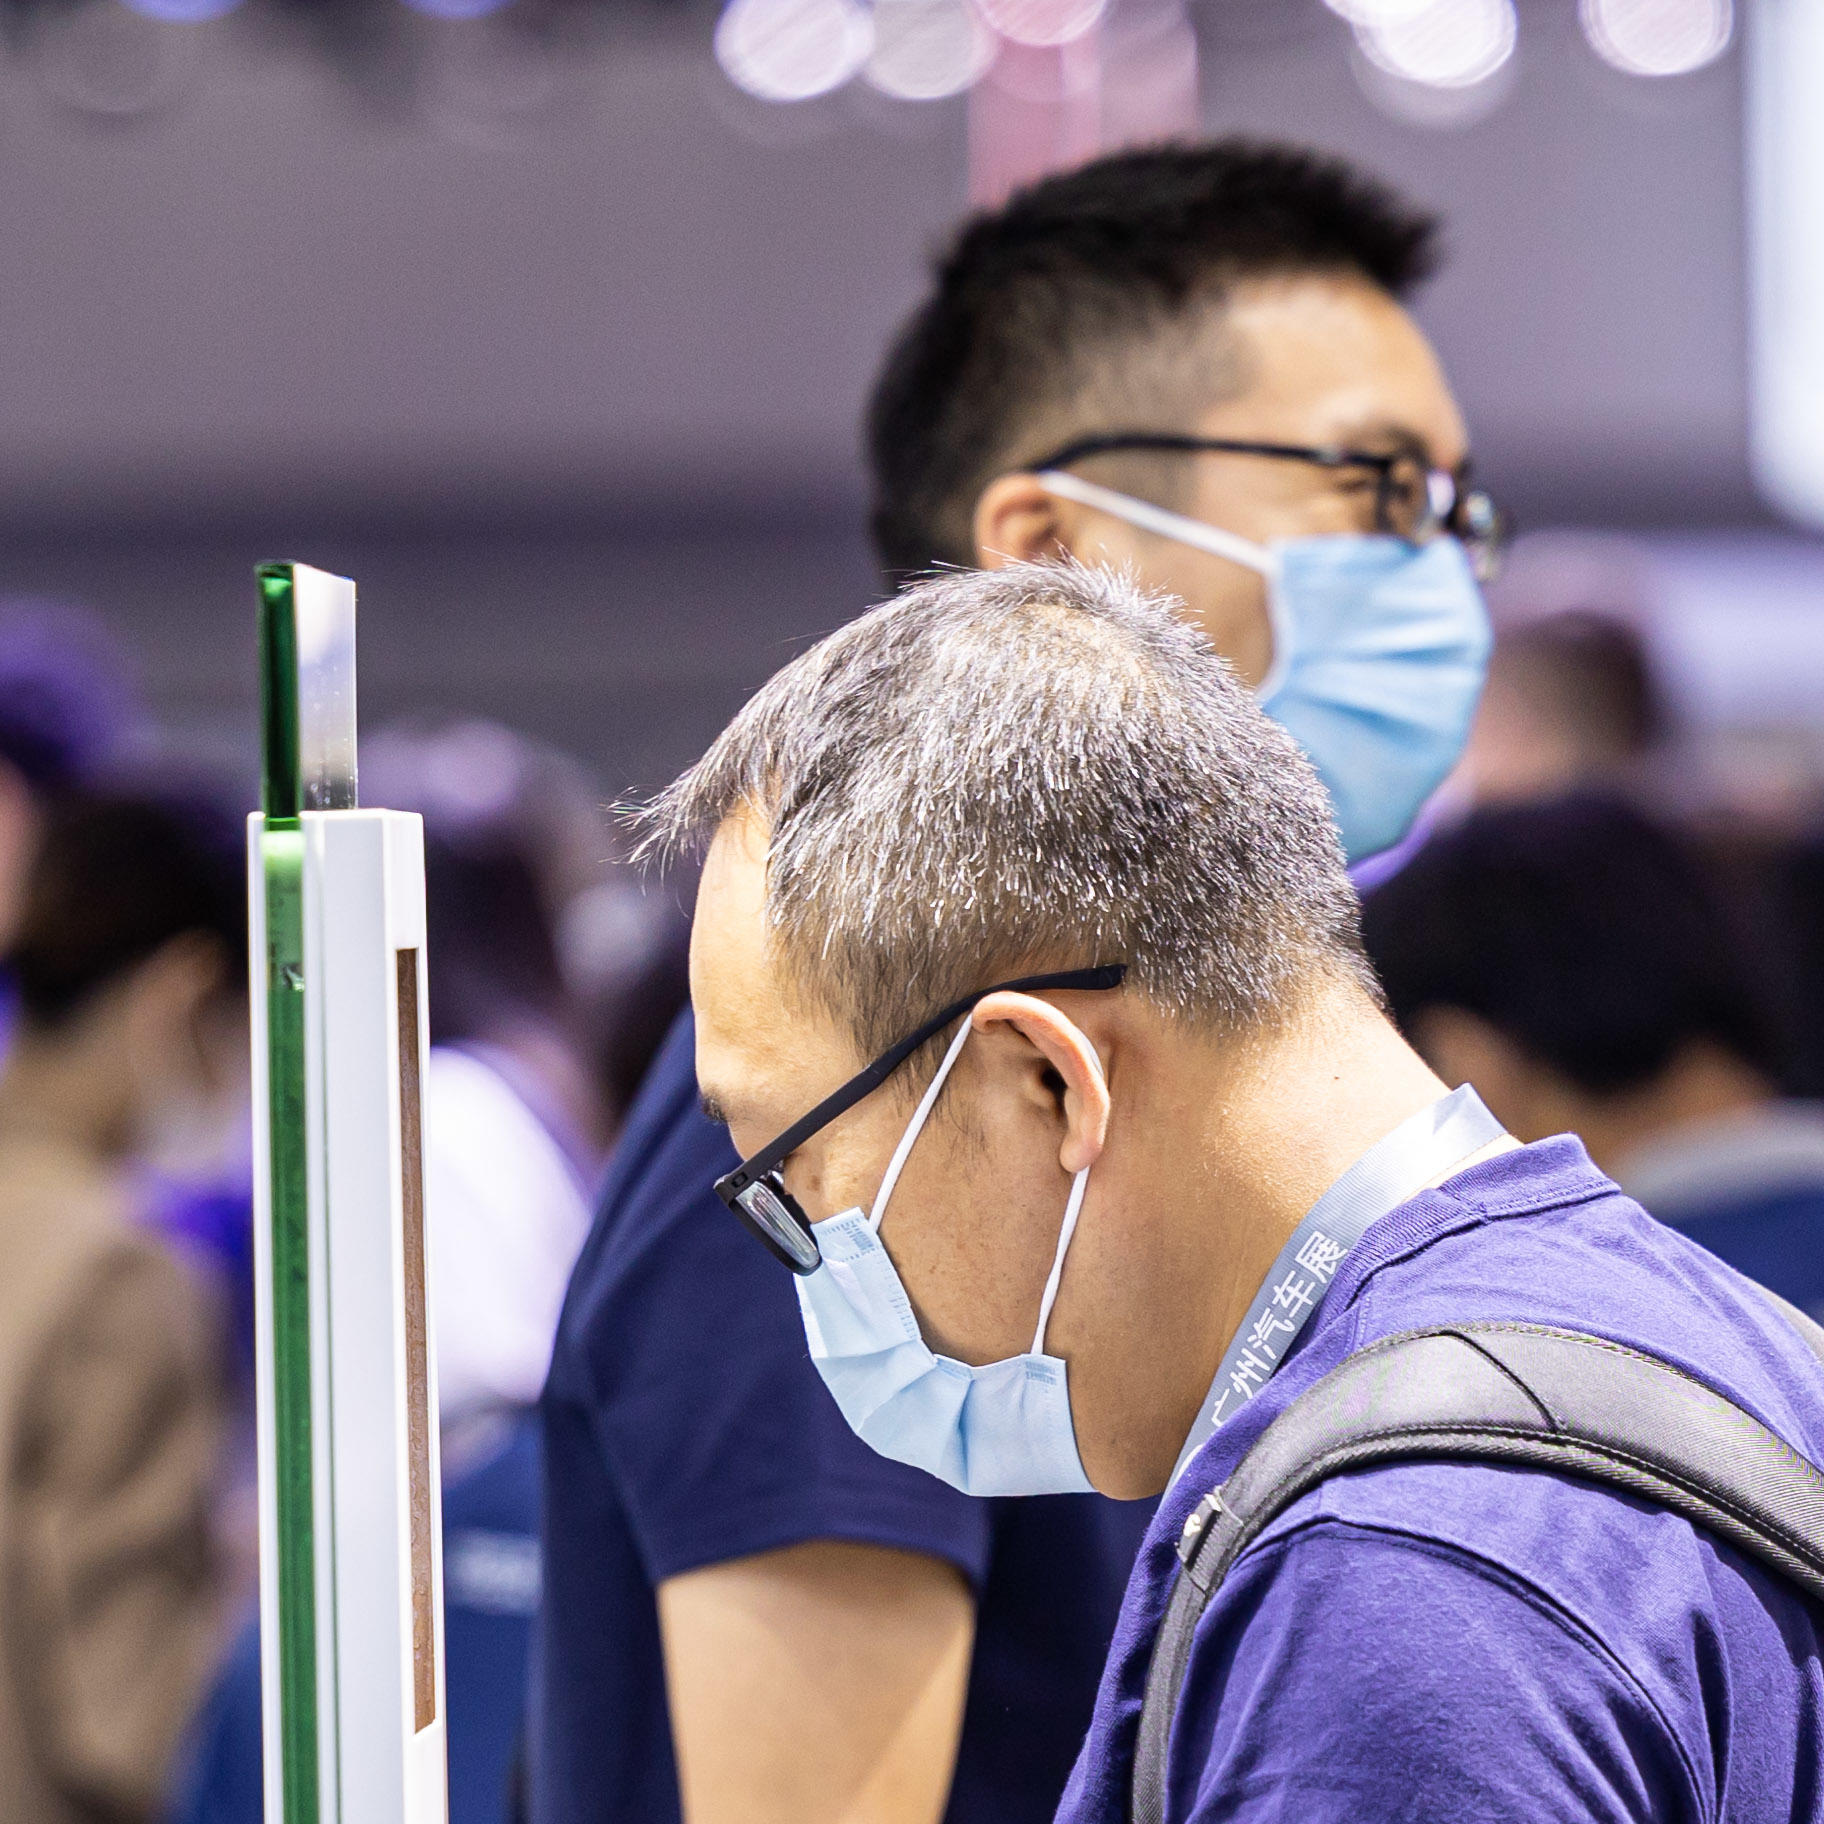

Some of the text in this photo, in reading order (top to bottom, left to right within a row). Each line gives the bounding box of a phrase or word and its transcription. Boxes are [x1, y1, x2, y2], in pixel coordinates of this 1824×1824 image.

[1210, 1230, 1348, 1427] 广州汽车展
